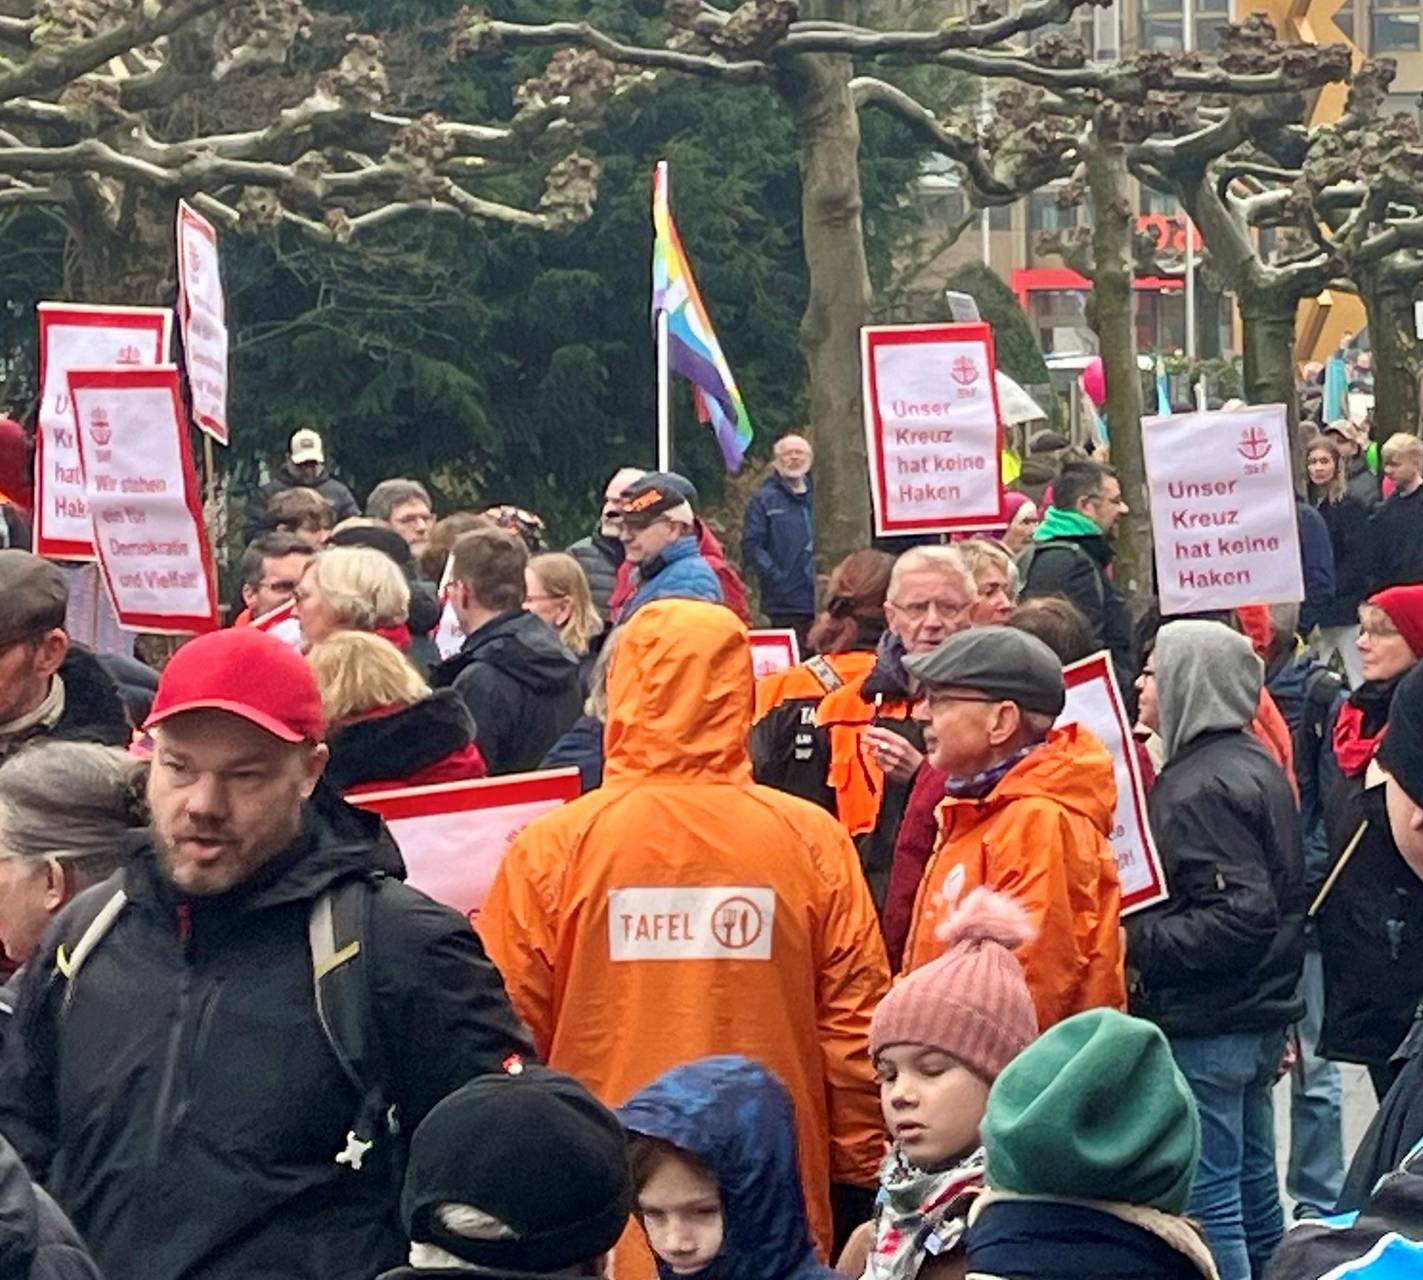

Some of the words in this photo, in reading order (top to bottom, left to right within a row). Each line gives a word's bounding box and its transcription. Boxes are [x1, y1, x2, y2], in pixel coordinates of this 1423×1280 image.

[892, 401, 952, 417] Unser
[896, 428, 953, 445] Kreuz
[897, 456, 929, 474] hat
[934, 454, 986, 473] keine
[95, 474, 117, 492] Wir
[1168, 479, 1238, 498] Unser
[900, 484, 961, 502] Haken
[1172, 509, 1240, 529] Kreuz
[1175, 538, 1212, 560] hat
[1217, 535, 1280, 555] keine
[119, 571, 141, 588] und
[1178, 568, 1251, 589] Haken
[620, 912, 695, 941] TAFEL
